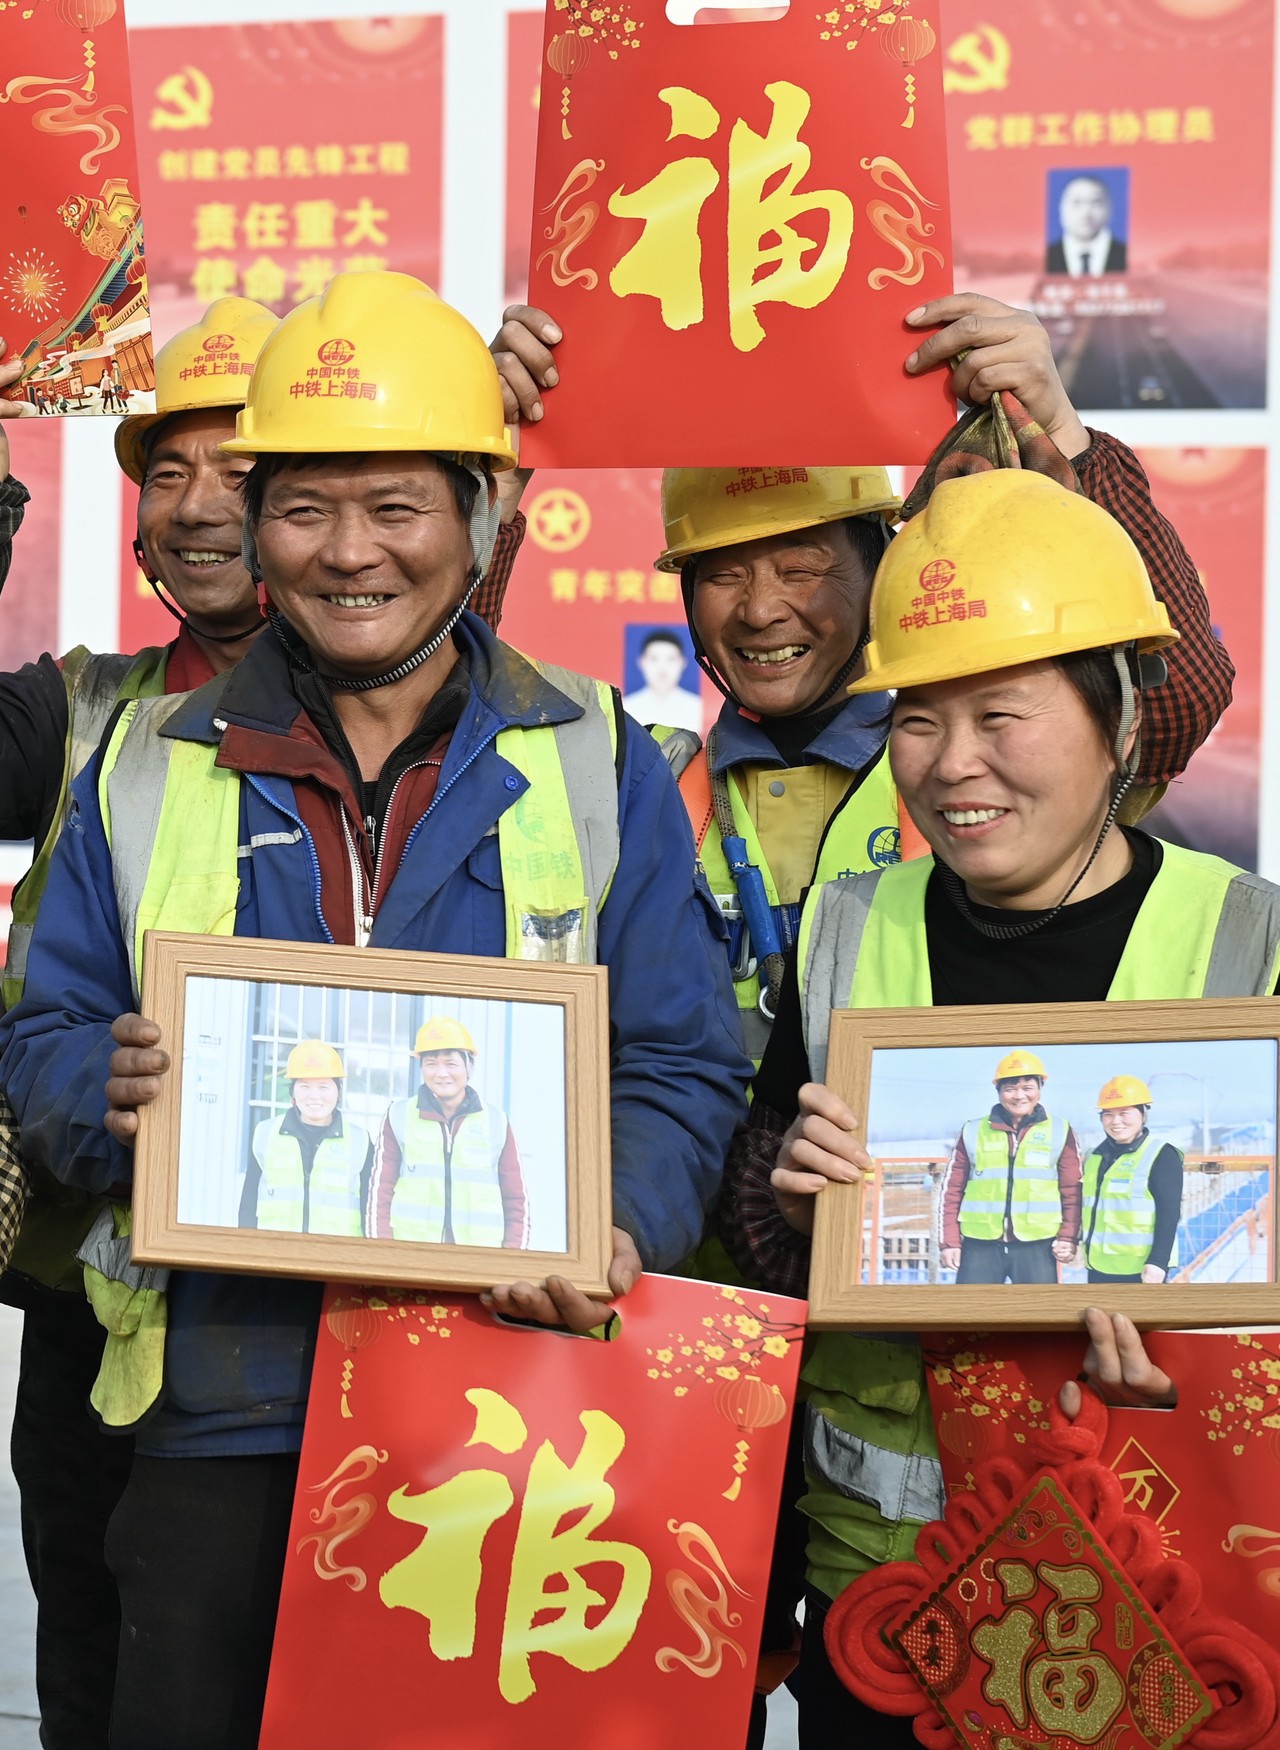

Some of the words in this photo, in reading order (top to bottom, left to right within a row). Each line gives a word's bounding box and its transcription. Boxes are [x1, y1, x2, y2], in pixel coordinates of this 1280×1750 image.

[193, 198, 388, 251] 责任重大
[608, 80, 854, 352] 福
[179, 362, 254, 382] 中铁上海局
[193, 352, 241, 365] 中国中铁
[306, 366, 360, 380] 中国中铁
[289, 380, 377, 400] 中铁上海局
[725, 467, 809, 498] 中铁上海局
[911, 587, 966, 610] 中国中铁
[899, 600, 987, 634] 中铁上海局
[1119, 1468, 1159, 1511] 万
[379, 1387, 652, 1705] 福
[971, 1557, 1126, 1746] 福
